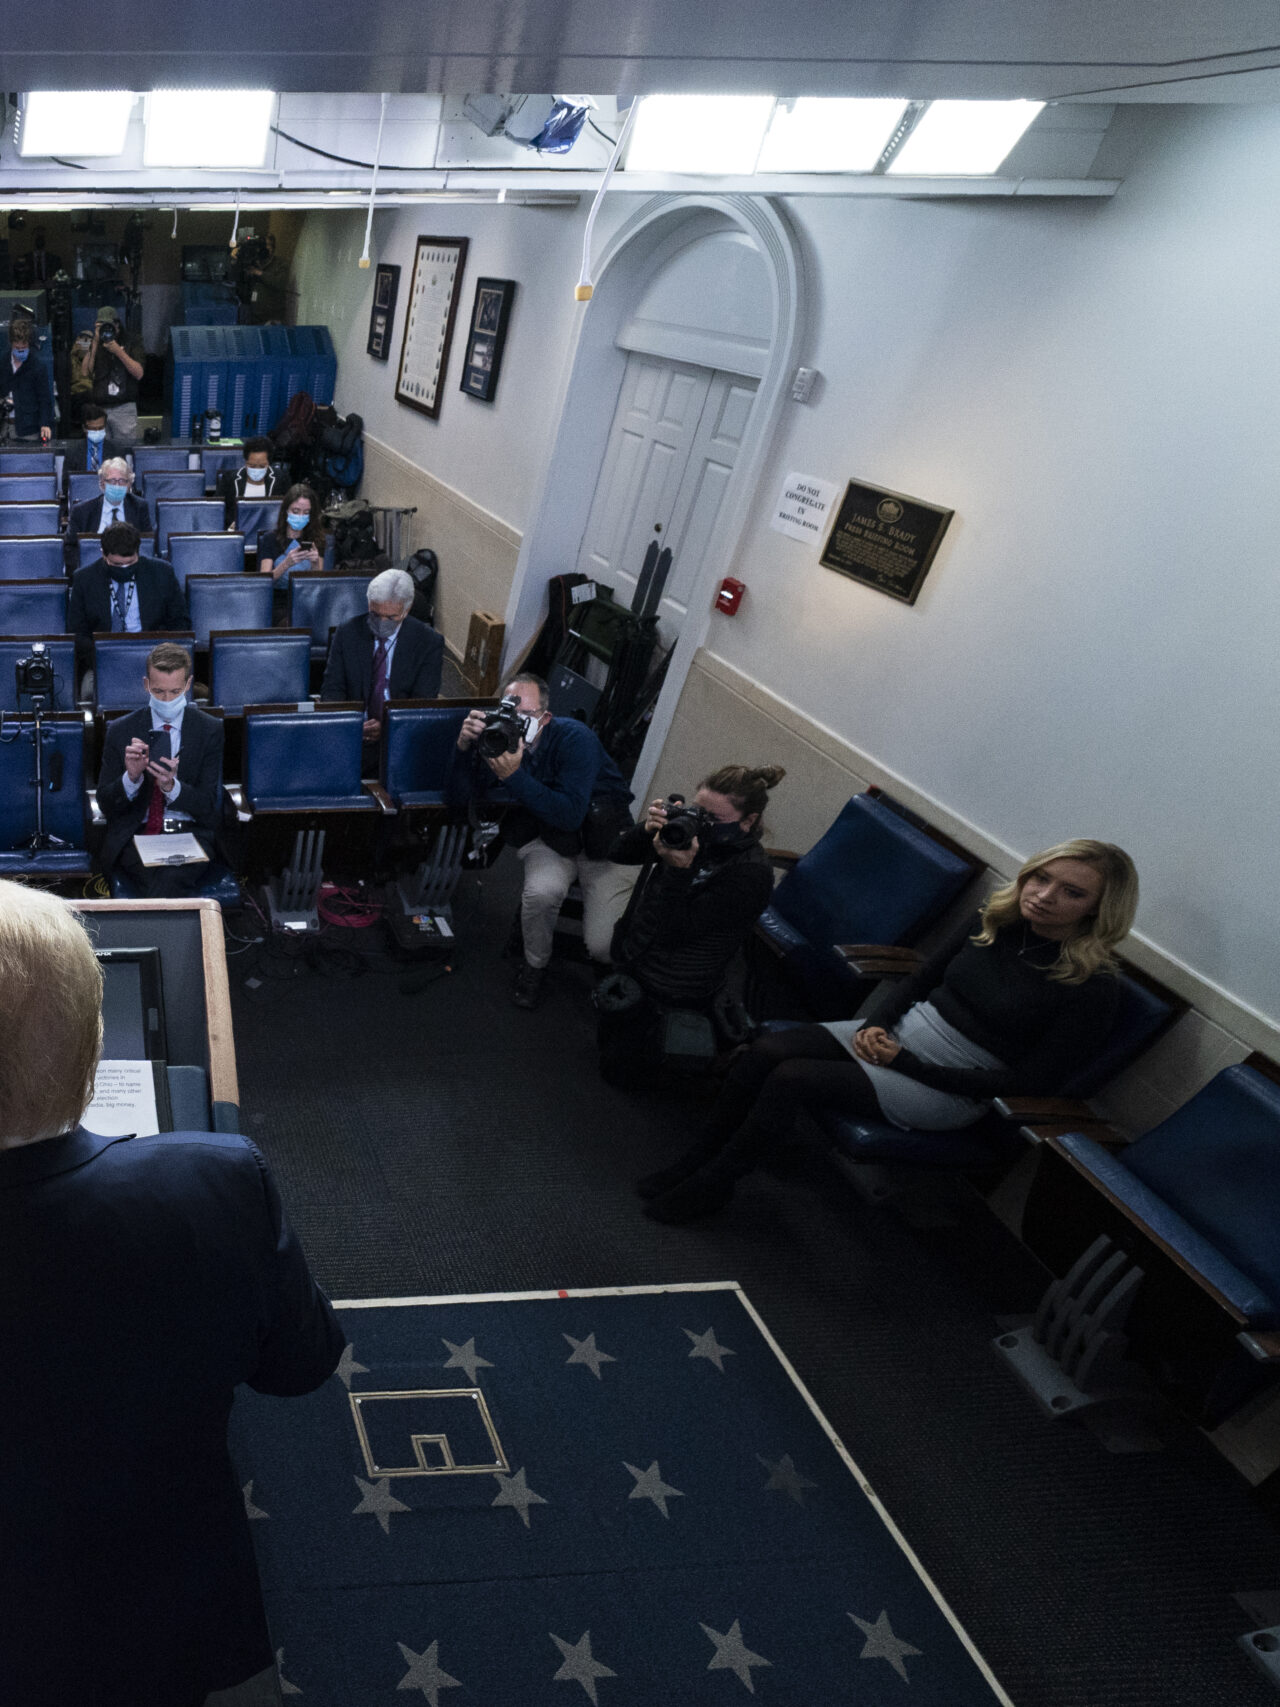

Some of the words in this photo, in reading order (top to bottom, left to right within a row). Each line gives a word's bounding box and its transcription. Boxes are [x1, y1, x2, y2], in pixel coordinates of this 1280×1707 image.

[785, 490, 826, 511] CONGREGATE
[796, 483, 807, 493] DO
[807, 486, 821, 498] NOT
[852, 513, 876, 529] JAMES
[888, 525, 917, 543] BRADY
